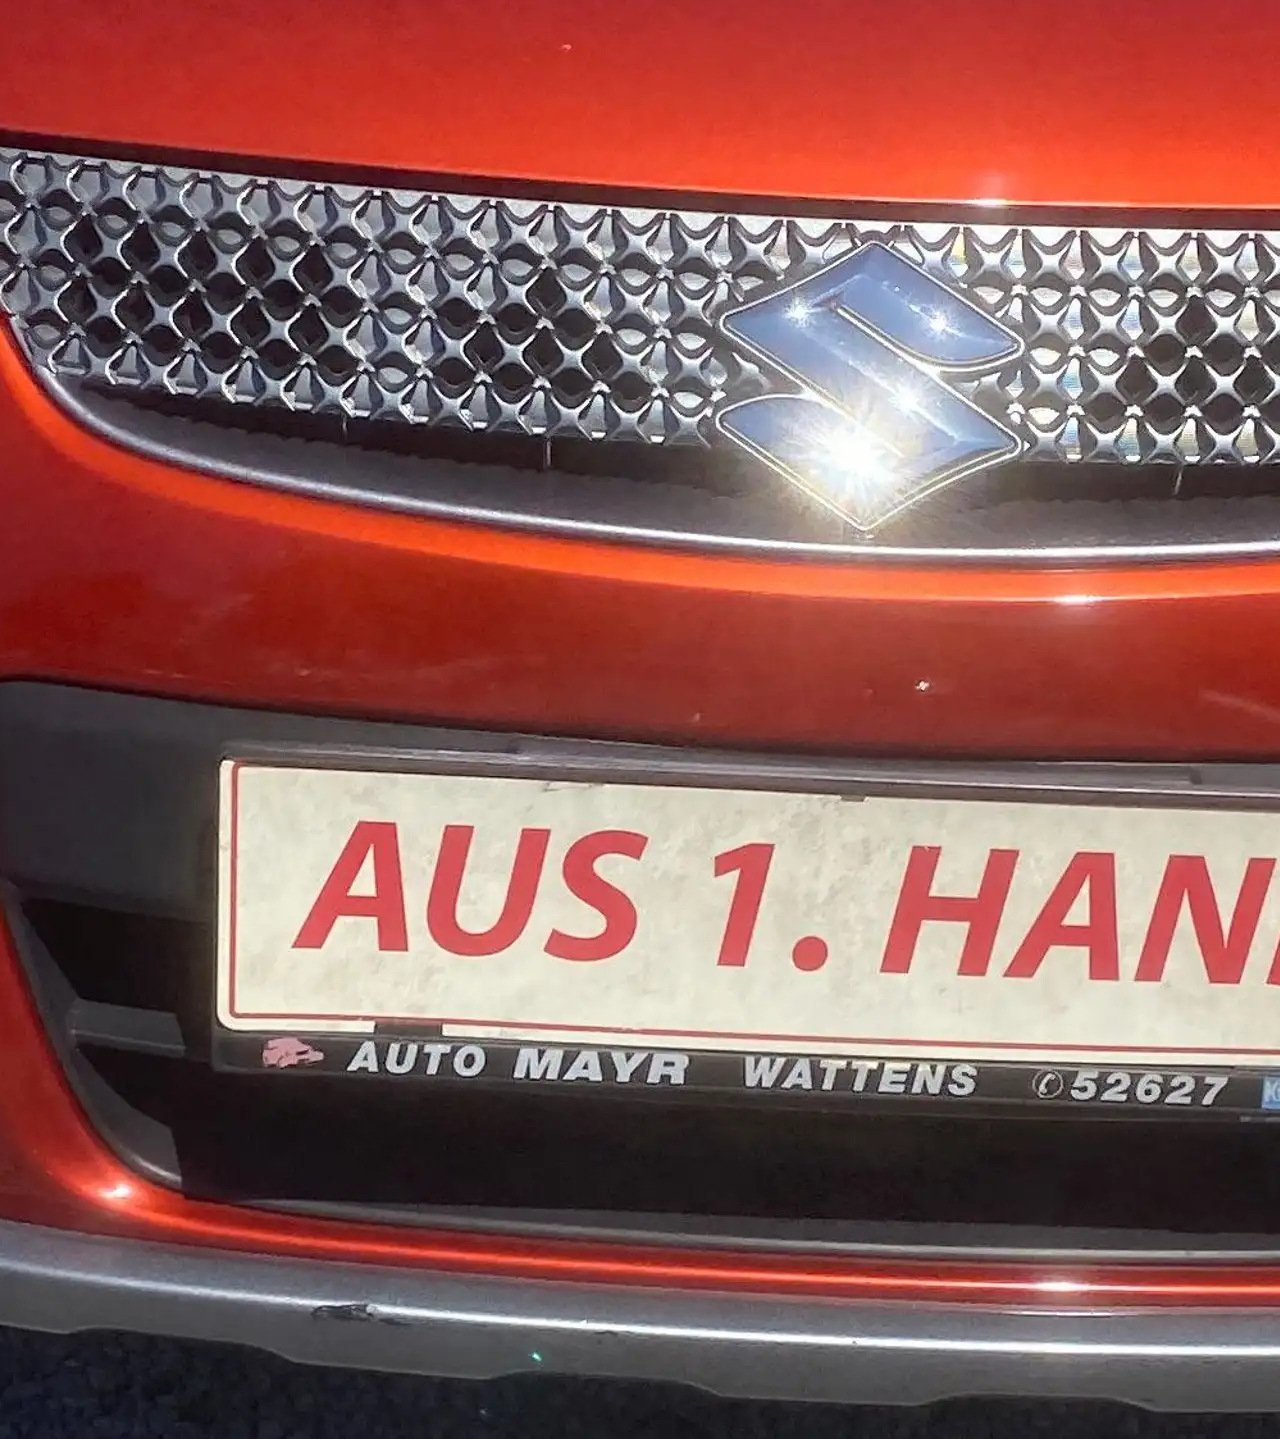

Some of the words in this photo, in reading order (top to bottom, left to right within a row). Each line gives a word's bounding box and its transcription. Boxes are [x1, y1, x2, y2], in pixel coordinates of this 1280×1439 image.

[291, 820, 649, 962] AUS
[714, 843, 829, 972] 1.
[347, 1040, 487, 1078] AUTO
[513, 1047, 691, 1085] MAYR
[743, 1056, 979, 1097] WATTENS
[1070, 1068, 1229, 1107] 52627
